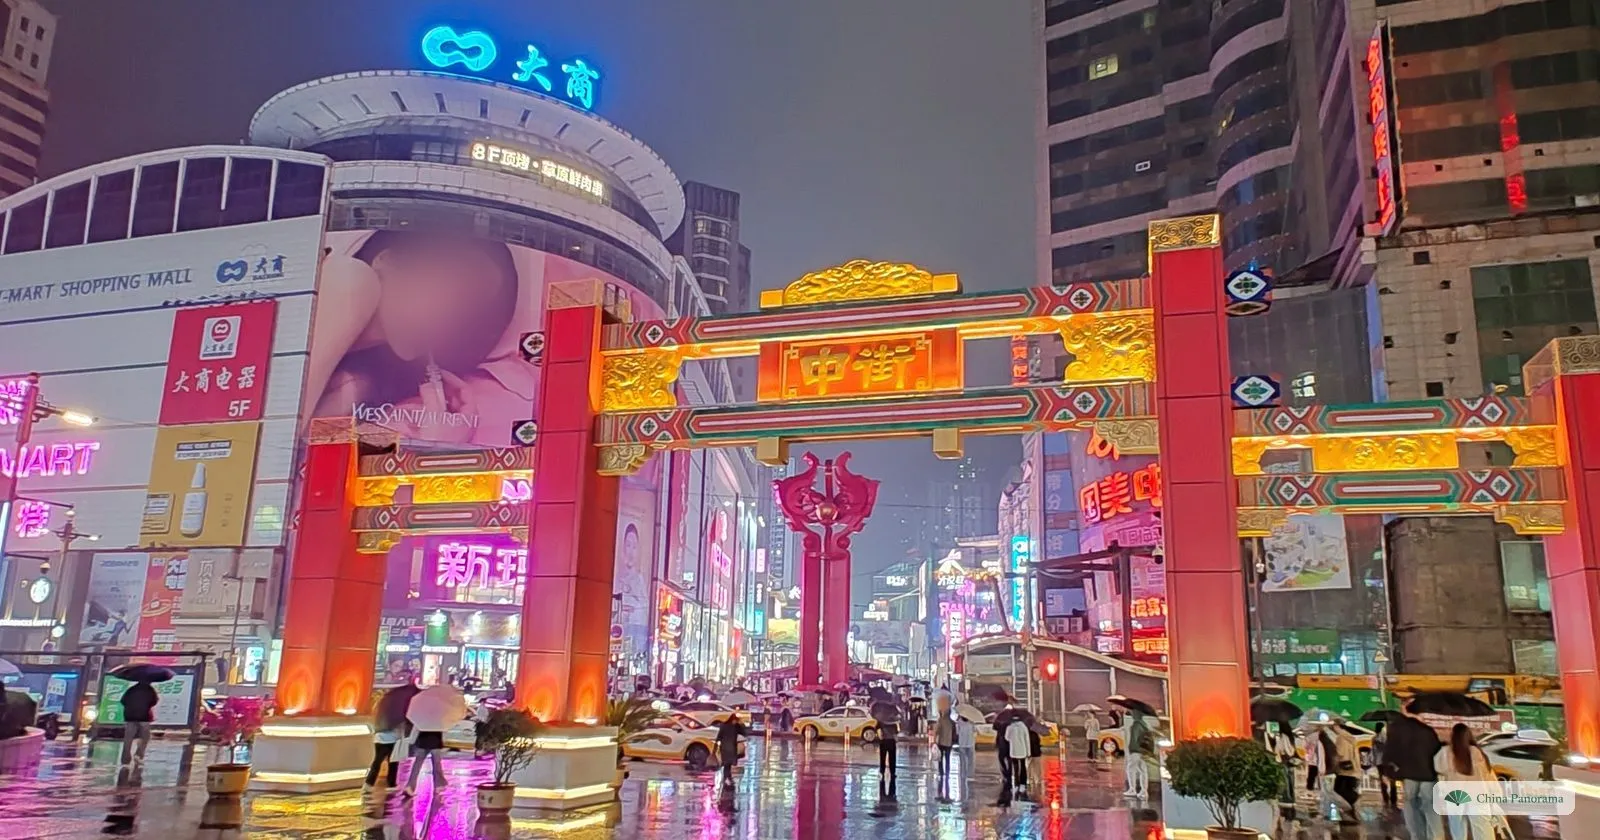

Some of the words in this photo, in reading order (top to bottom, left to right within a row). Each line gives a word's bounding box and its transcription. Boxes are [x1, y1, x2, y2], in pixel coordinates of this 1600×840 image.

[511, 44, 600, 108] 大商
[0, 283, 55, 303] -MART
[59, 274, 140, 297] SHOPPING
[147, 268, 192, 286] MALL
[172, 364, 256, 394] 大商电器
[800, 344, 916, 396] 中街
[228, 400, 251, 417] 5F
